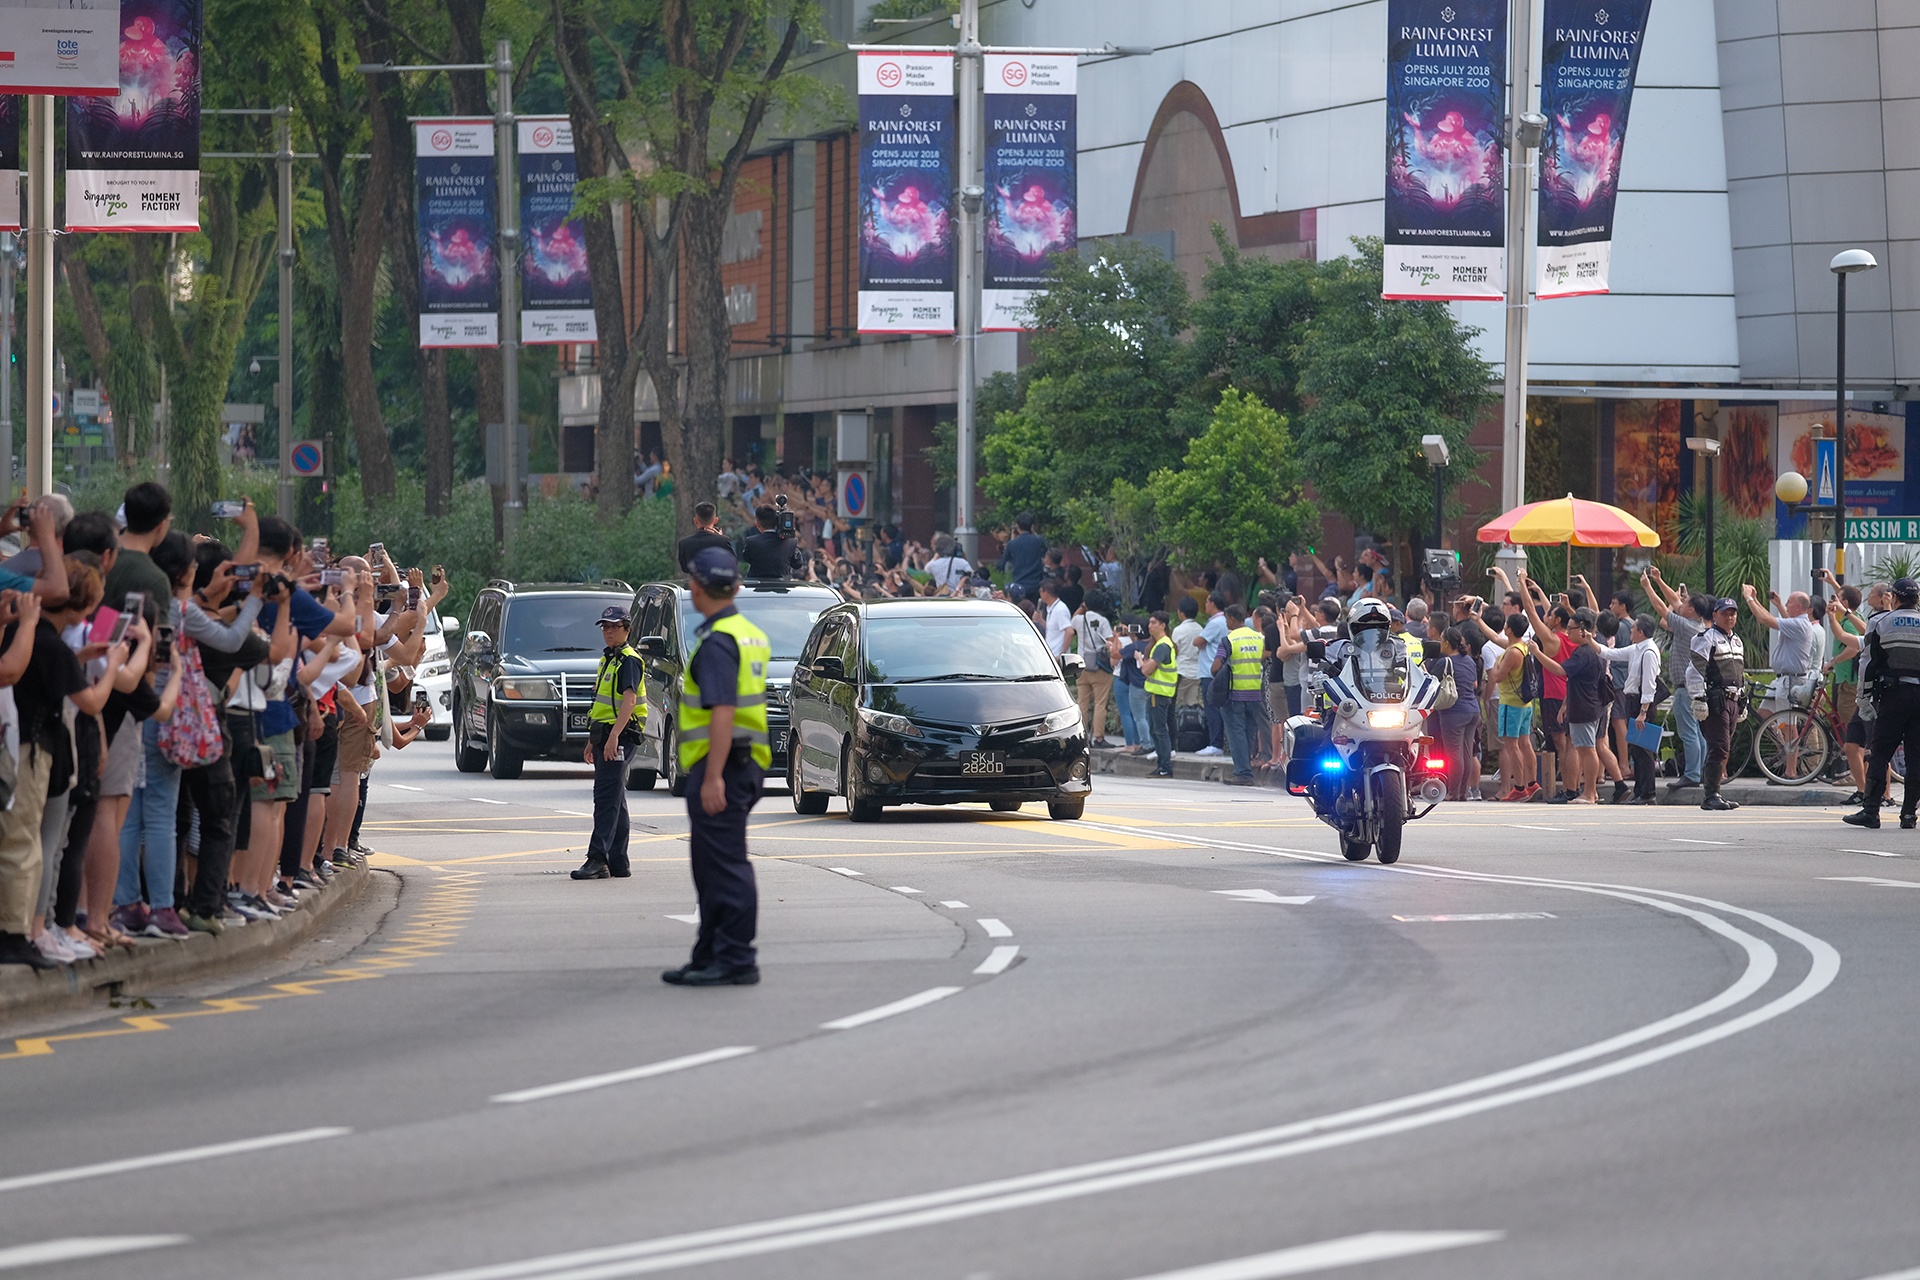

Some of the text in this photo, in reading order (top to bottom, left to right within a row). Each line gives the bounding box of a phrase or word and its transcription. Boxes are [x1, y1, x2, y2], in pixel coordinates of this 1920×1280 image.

[1401, 26, 1494, 42] RAINFOREST
[57, 39, 78, 49] tote
[1415, 43, 1480, 59] LUMINA
[1570, 45, 1629, 60] LUMINA
[880, 69, 899, 80] SG
[1005, 69, 1024, 80] SG
[1404, 64, 1490, 76] OPENS JULY 2018
[1558, 66, 1591, 77] OPENS
[1592, 67, 1616, 77] JULY
[1404, 76, 1490, 88] SINGAPORE ZOO
[1557, 78, 1614, 89] SINGAPORE
[868, 120, 942, 132] RAINFOREST
[994, 119, 1067, 131] RAINFOREST
[880, 133, 931, 145] LUMINA
[1005, 132, 1056, 144] LUMINA
[80, 150, 184, 159] WWW.RAINFORESTLUMINA.SG
[872, 150, 940, 159] OPENS JULY 2018
[997, 149, 1065, 158] OPENS JULY 2018
[871, 159, 940, 169] SINGAPORE ZOO
[997, 158, 1065, 168] SINGAPORE ZOO
[425, 176, 485, 186] RAINFOREST
[435, 186, 476, 197] LUMINA
[83, 189, 122, 208] Singapore
[141, 192, 180, 202] MOMENT
[530, 196, 552, 204] OPENS
[141, 202, 180, 211] FACTORY
[429, 207, 485, 215] SINGAPORE ZOO
[530, 204, 568, 212] SINGAPORE
[1398, 228, 1492, 238] WWW.RAINFORESTLUMINA.SG
[1399, 262, 1434, 278] Singapore
[1452, 266, 1488, 274] MOMENT
[1576, 261, 1599, 270] MOMENT
[1576, 270, 1599, 278] FACTORY
[1865, 487, 1896, 496] Aboard!
[1844, 520, 1920, 539] ASSIM R
[1893, 617, 1920, 627] POLIC
[1370, 692, 1402, 700] POLICE
[971, 752, 995, 763] SKJ
